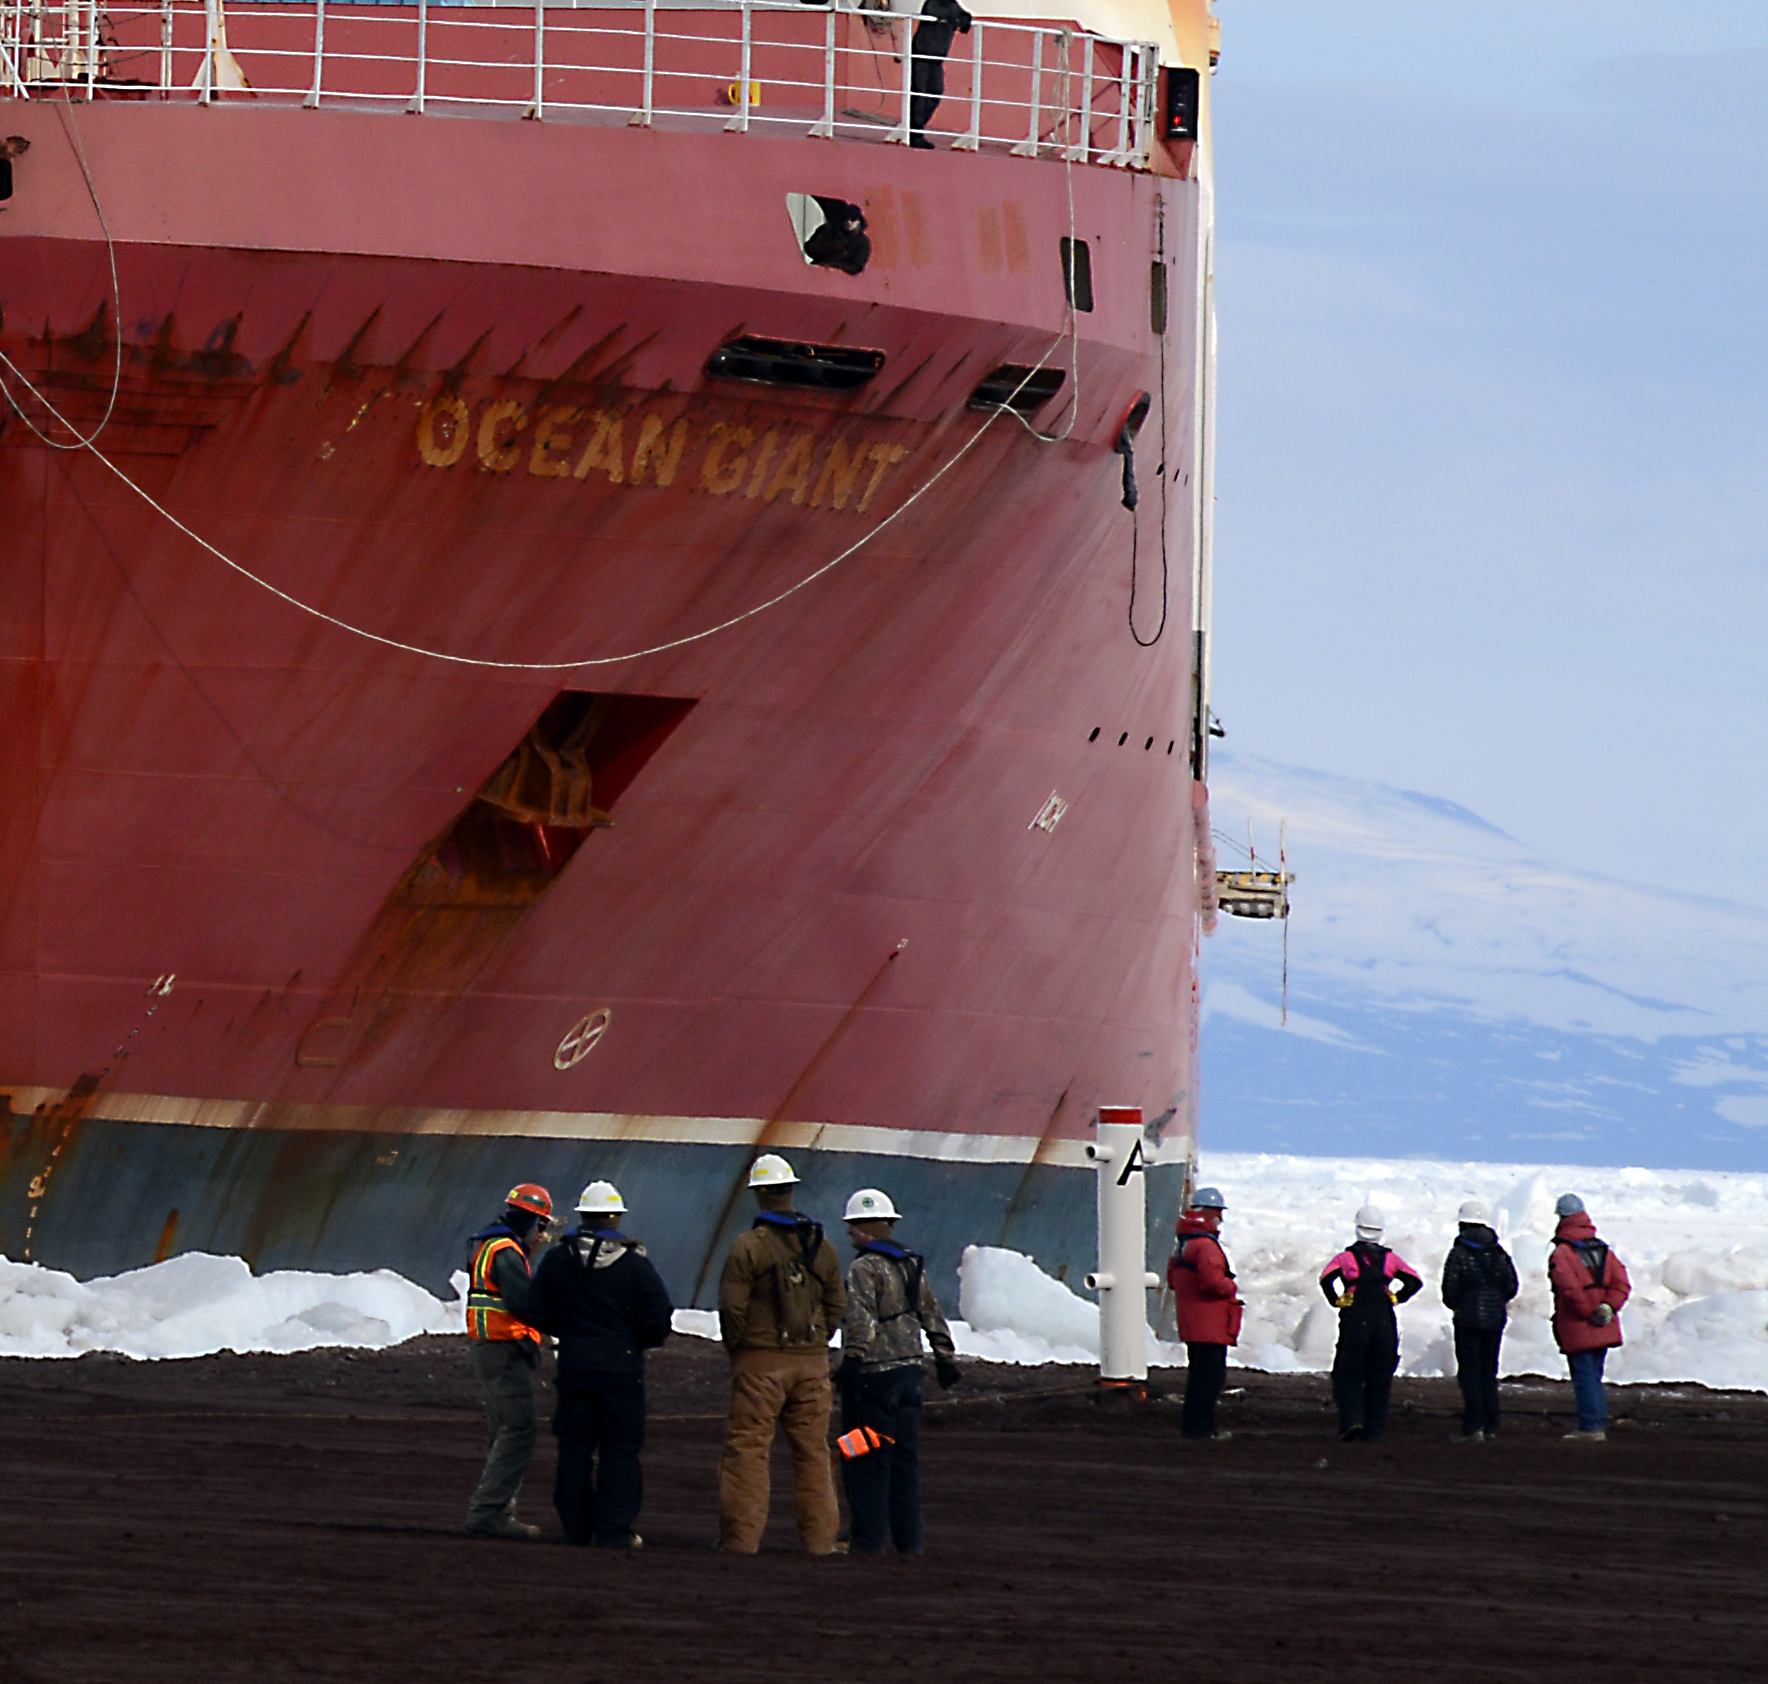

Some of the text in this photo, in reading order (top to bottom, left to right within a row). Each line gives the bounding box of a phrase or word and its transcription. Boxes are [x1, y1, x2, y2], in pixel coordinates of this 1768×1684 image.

[416, 396, 908, 513] OCEAN GIANT
[1117, 1138, 1144, 1186] A
